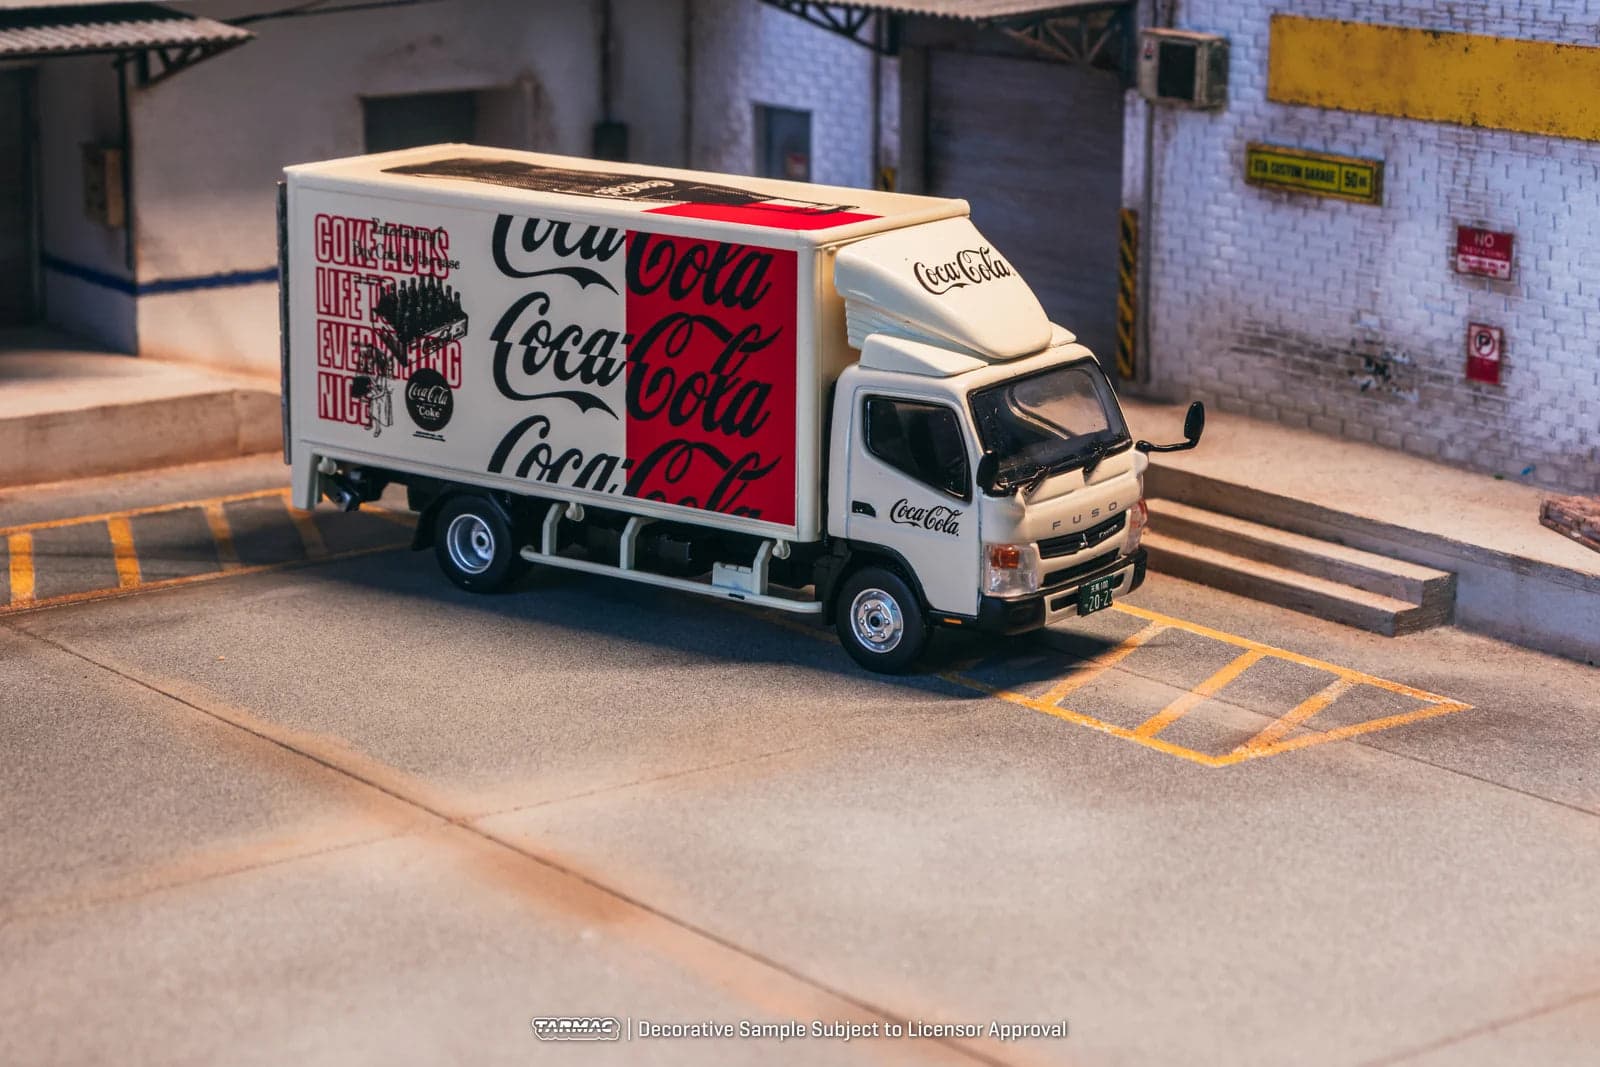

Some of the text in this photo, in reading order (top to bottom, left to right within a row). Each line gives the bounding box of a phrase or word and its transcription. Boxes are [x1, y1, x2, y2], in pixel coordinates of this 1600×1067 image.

[1304, 166, 1336, 184] GARAGE
[314, 214, 449, 279] COKE ADDS
[492, 214, 774, 310] CocaCola
[1474, 232, 1495, 249] NO
[316, 267, 361, 320] LIFE
[913, 246, 1012, 296] Coca-Cola
[1052, 501, 1118, 531] FUSO
